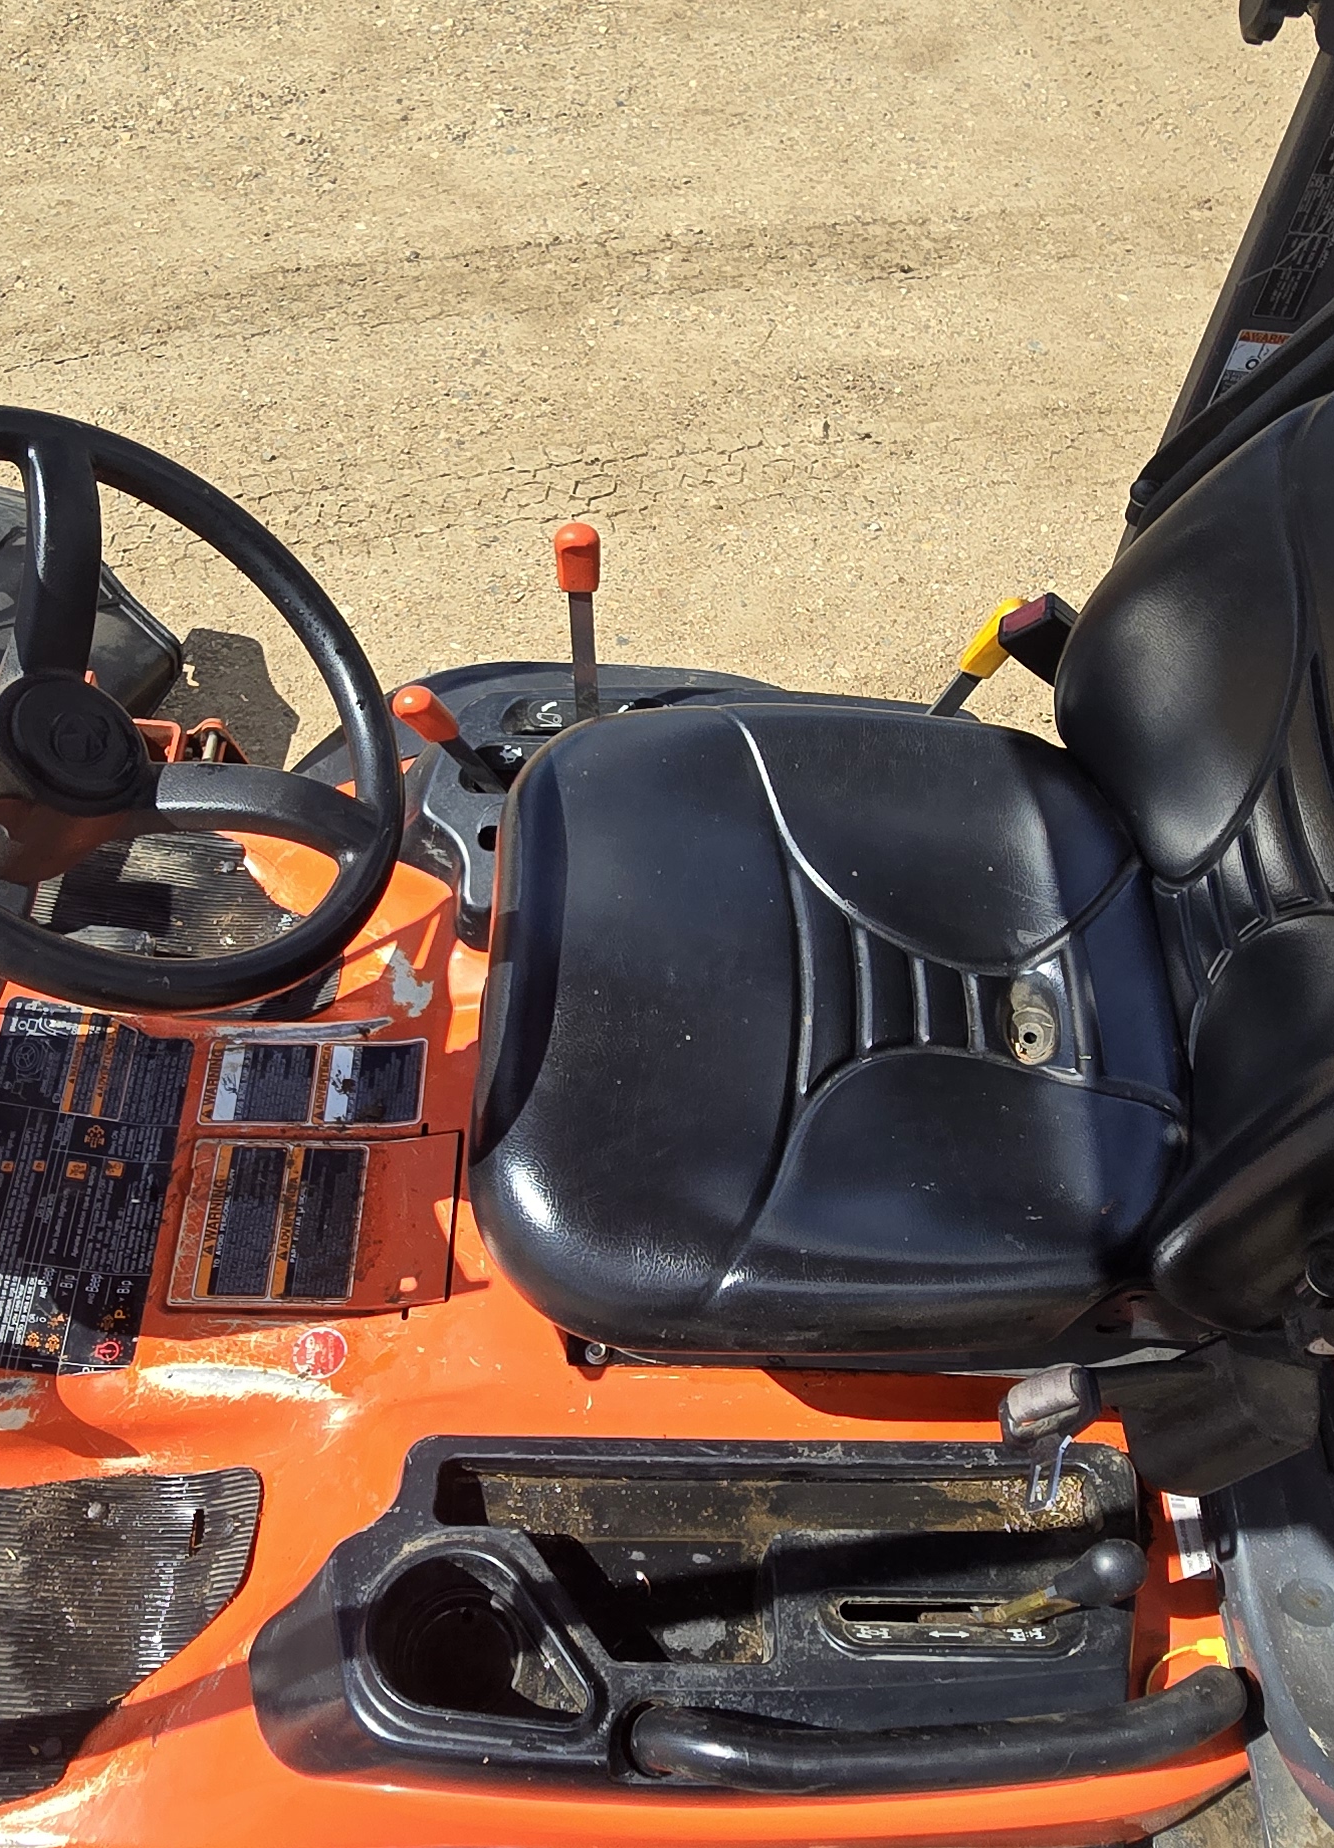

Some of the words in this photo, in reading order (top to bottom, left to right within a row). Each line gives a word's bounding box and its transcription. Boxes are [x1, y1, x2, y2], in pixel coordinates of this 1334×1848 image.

[202, 1048, 222, 1106] WARNING
[314, 1044, 331, 1109] ADVERTENCIA
[204, 1177, 226, 1242] WARNING
[214, 1233, 225, 1255] AVOID
[59, 1272, 79, 1290] Bip
[84, 1271, 105, 1294] Beep
[115, 1278, 134, 1296] Bip
